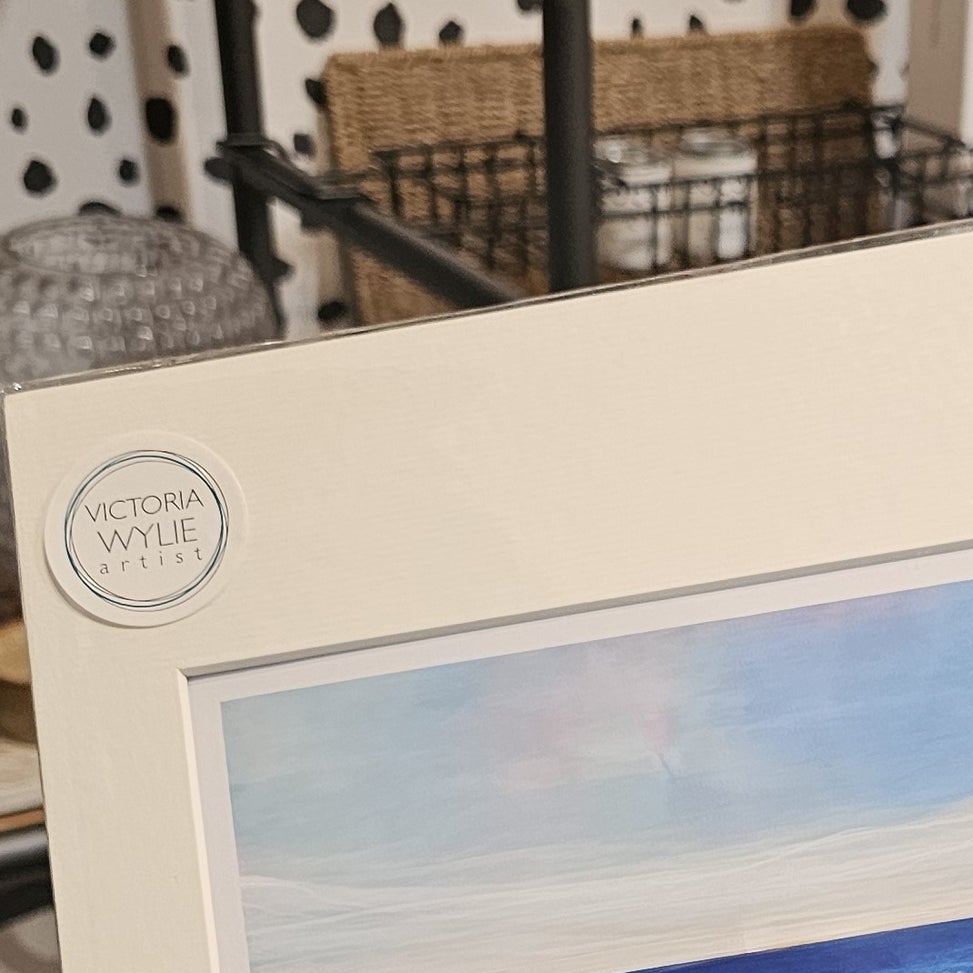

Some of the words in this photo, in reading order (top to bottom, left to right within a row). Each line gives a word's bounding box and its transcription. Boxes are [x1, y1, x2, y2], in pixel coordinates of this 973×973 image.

[84, 488, 204, 522] VICTORIA
[97, 517, 197, 553] WYLIE
[99, 547, 203, 575] artist
